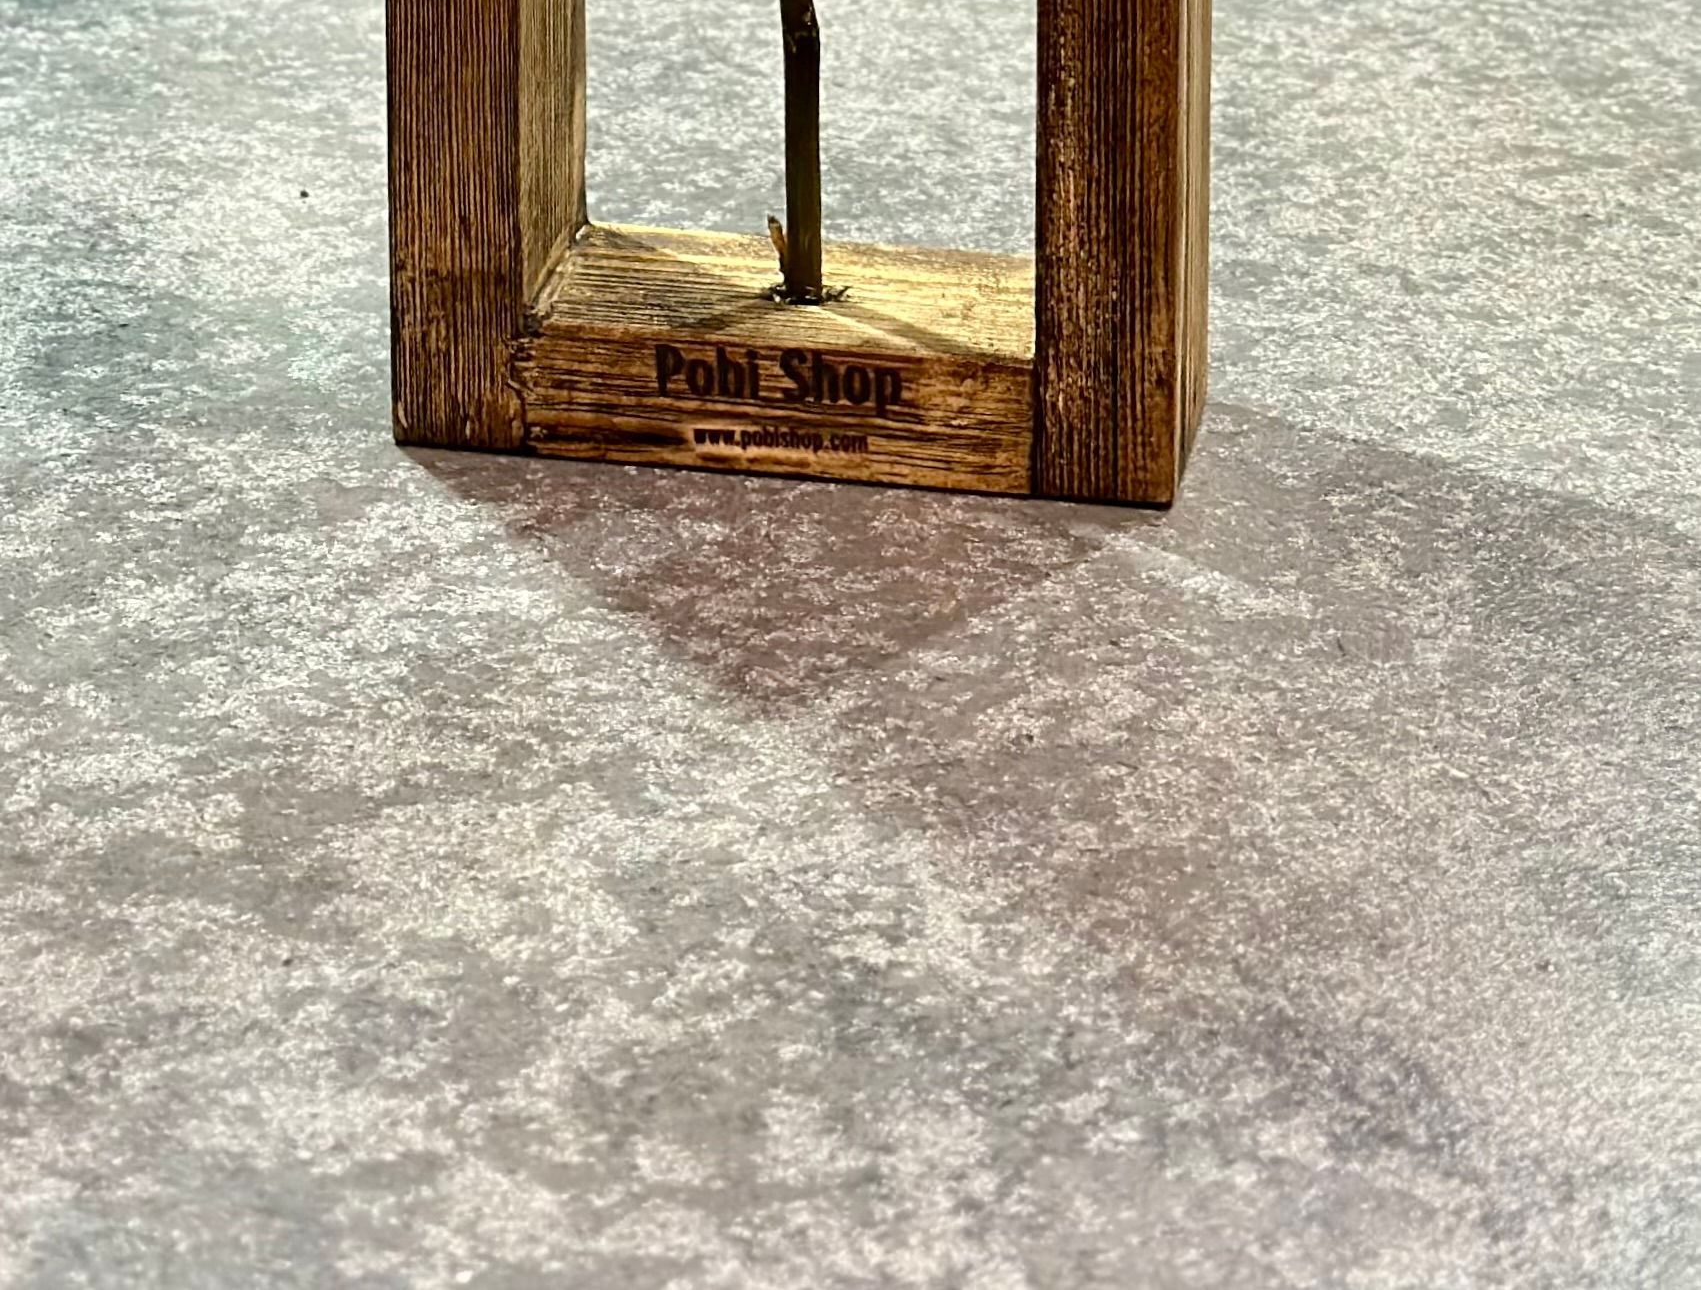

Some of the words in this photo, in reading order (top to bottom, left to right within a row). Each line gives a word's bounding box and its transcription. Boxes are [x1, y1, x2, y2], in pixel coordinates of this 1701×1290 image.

[655, 343, 760, 399] Pobi
[779, 347, 901, 416] Shop
[693, 427, 869, 453] www.pobishop.com
